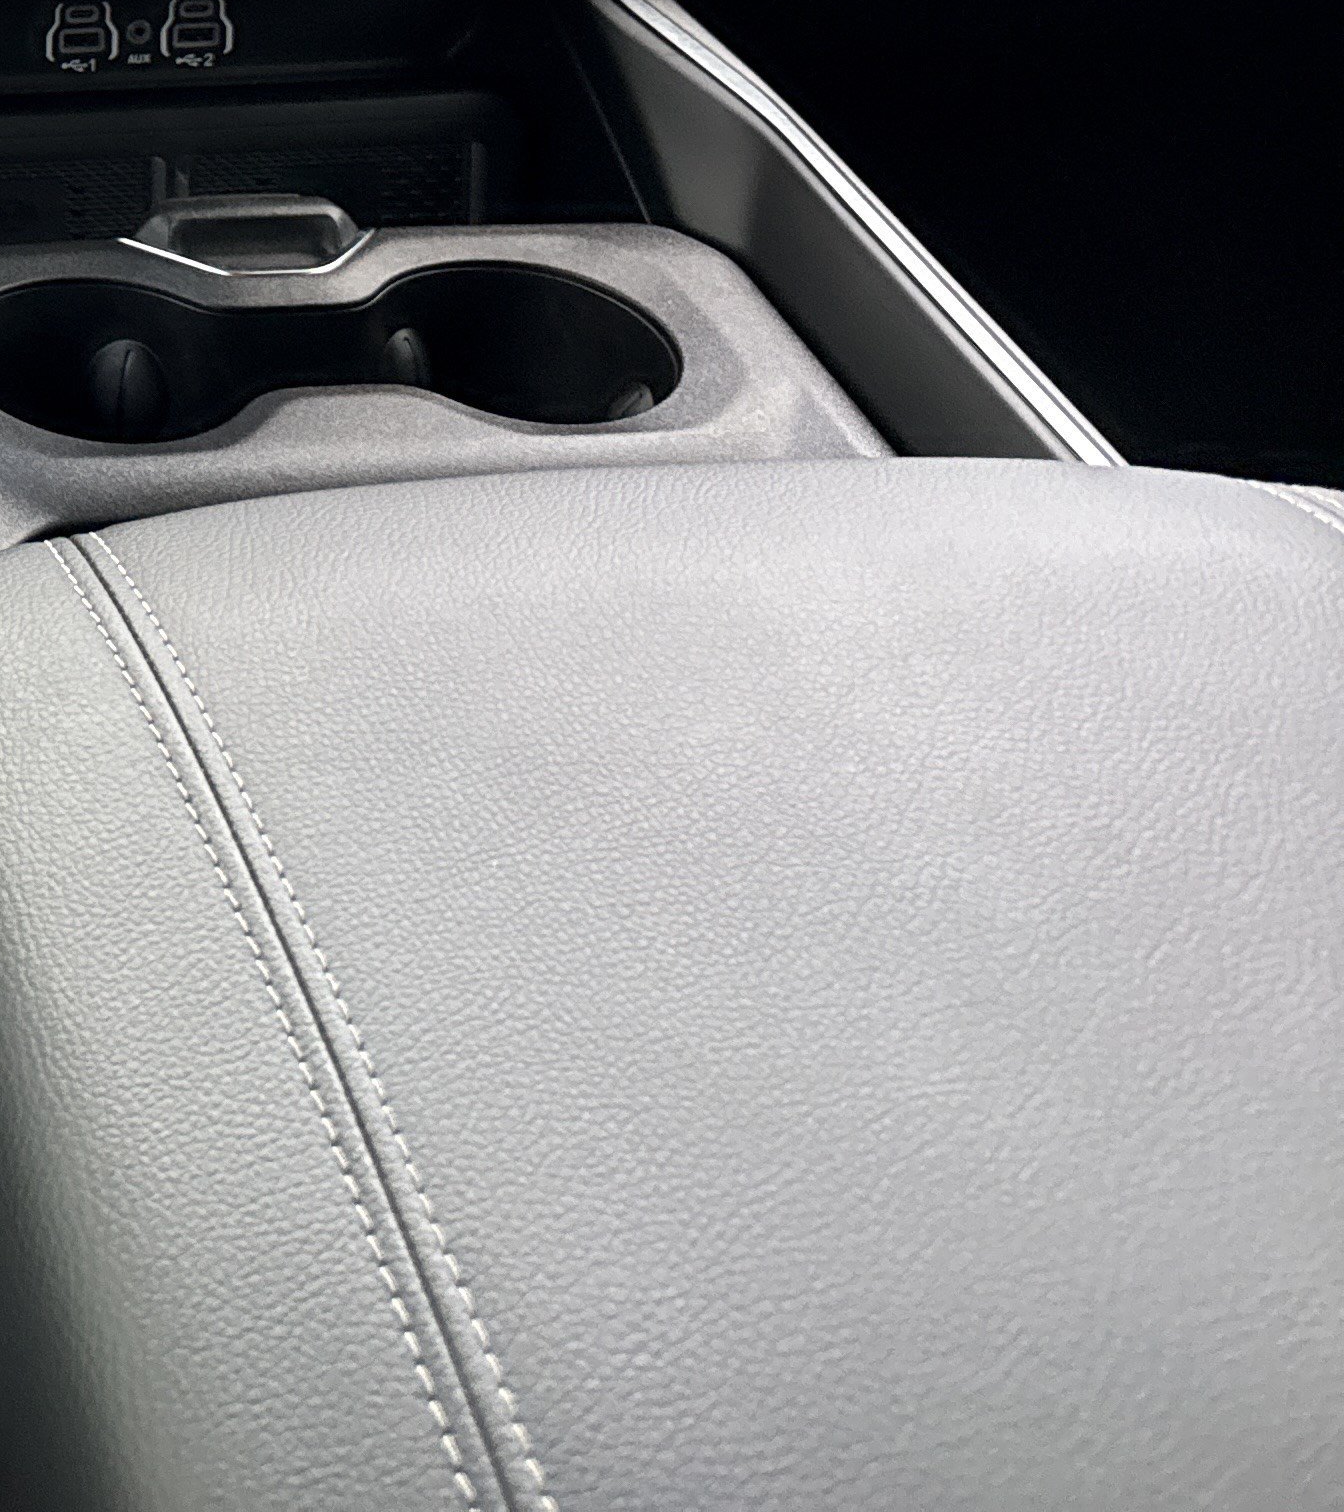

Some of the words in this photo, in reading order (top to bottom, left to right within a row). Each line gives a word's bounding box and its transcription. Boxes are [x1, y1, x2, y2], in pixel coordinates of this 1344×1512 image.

[89, 58, 97, 72] 1
[127, 53, 152, 65] AUX
[203, 53, 215, 67] 2
